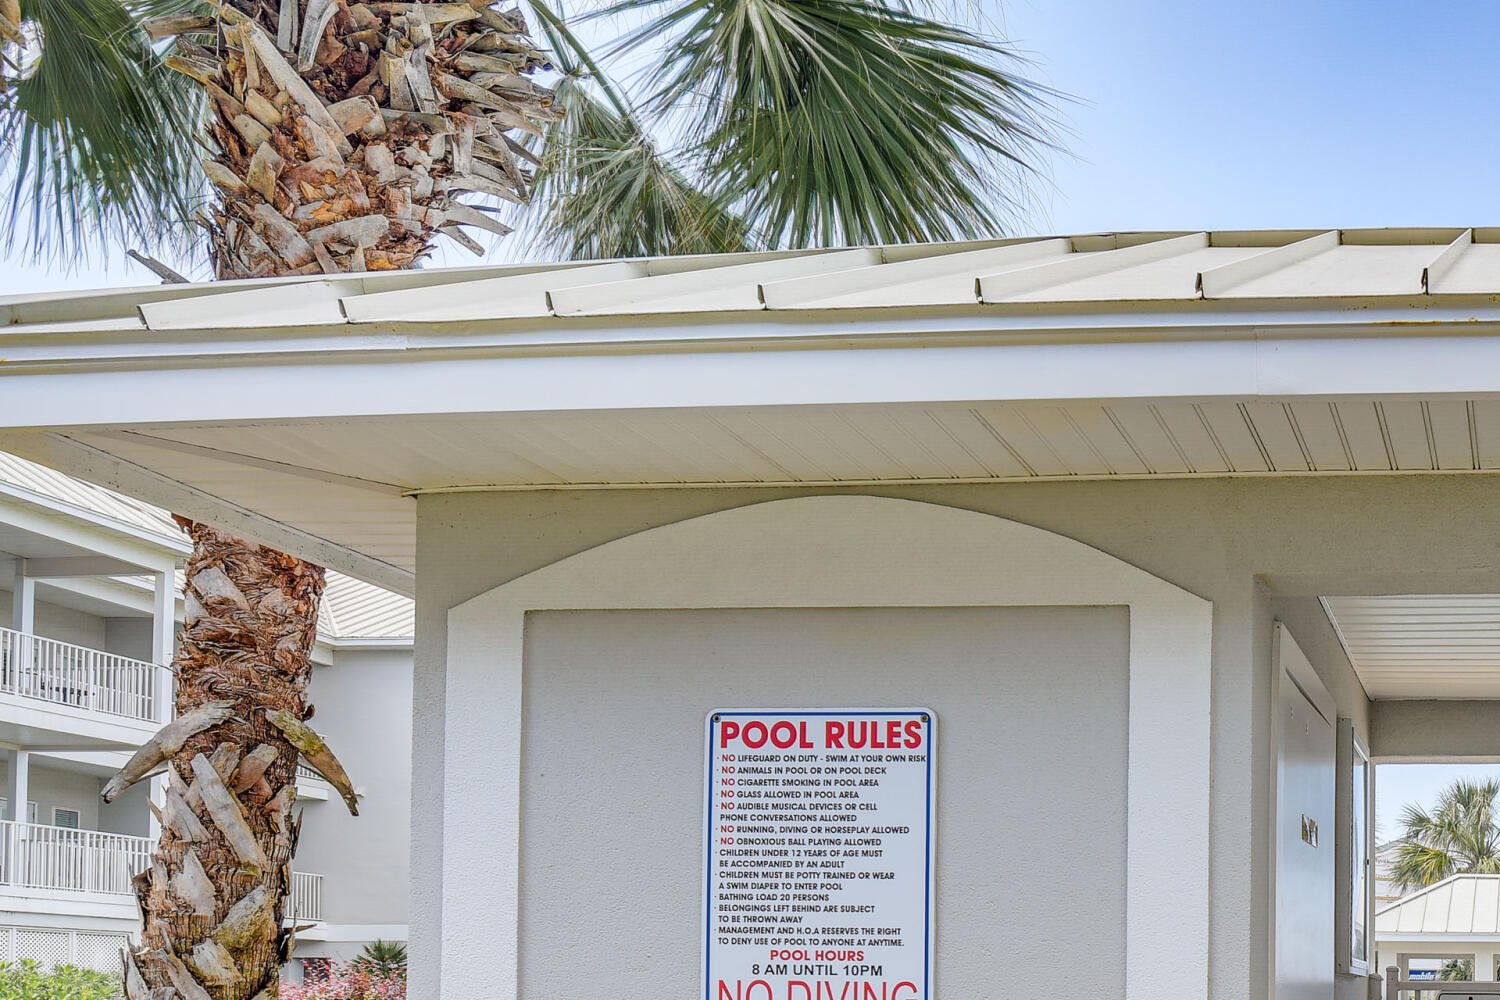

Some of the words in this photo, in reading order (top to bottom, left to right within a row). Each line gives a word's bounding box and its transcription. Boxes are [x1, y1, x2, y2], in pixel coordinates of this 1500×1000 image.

[721, 721, 814, 749] POOL
[825, 721, 922, 749] RULES
[722, 754, 735, 762] NO
[738, 754, 781, 762] LIFEGUARD
[783, 755, 796, 763] ON
[798, 755, 818, 763] DUTY
[825, 755, 847, 763] SWIM
[850, 755, 859, 763] AT
[861, 755, 884, 763] YOUR
[886, 755, 906, 763] OWN
[908, 755, 926, 763] RISK
[721, 766, 735, 775] NO
[737, 766, 772, 775] ANIMALS
[774, 766, 783, 775] IN
[785, 767, 808, 775] POOL
[810, 767, 822, 775] OR
[824, 767, 837, 775] ON
[839, 767, 862, 775] POOL
[864, 767, 887, 775] DECK
[721, 778, 735, 787] NO
[737, 778, 780, 787] CIGARETTE
[782, 779, 821, 787] SMOKING
[823, 779, 832, 787] IN
[834, 779, 856, 787] POOL
[858, 779, 879, 787] AREA
[721, 791, 734, 799] NO
[737, 791, 762, 799] GLASS
[763, 791, 801, 799] ALLOWED
[803, 791, 812, 799] IN
[814, 791, 836, 799] POOL
[838, 791, 859, 799] AREA
[721, 803, 735, 811] NO
[737, 803, 769, 811] AUDIBLE
[771, 803, 807, 811] MUSICAL
[809, 803, 842, 811] DEVICES
[845, 803, 857, 811] OR
[859, 803, 878, 811] CELL
[720, 814, 748, 822] PHONE
[750, 814, 817, 822] CONVERSATIONS
[819, 814, 857, 822] ALLOWED
[721, 825, 734, 834] NO
[780, 826, 808, 834] DIVING
[810, 826, 822, 834] OR
[825, 826, 870, 834] HORSEPLAY
[872, 826, 910, 835] ALLOWED
[721, 837, 734, 846] NO
[736, 837, 786, 846] OBNOXIOUS
[788, 837, 806, 846] BALL
[808, 838, 842, 846] PLAYING
[844, 838, 881, 846] ALLOWED
[719, 849, 759, 857] CHILDREN
[861, 850, 883, 858] MUST
[719, 860, 728, 868] BE
[730, 861, 792, 869] ACCOMPANIED
[795, 861, 805, 869] BY
[806, 861, 818, 869] AN
[820, 861, 845, 869] ADULT
[719, 872, 759, 880] CHILDREN
[762, 872, 783, 880] MUST
[785, 872, 794, 880] BE
[797, 872, 821, 880] POTTY
[823, 872, 856, 880] TRAINED
[858, 872, 870, 880] OR
[872, 872, 895, 880] WEAR
[718, 882, 724, 890] A
[781, 883, 792, 891] TO
[795, 883, 818, 891] ENTER
[820, 883, 843, 891] POOL
[756, 894, 778, 902] LOAD
[780, 894, 790, 902] 20
[793, 894, 829, 902] PERSONS
[718, 905, 771, 913] BELONGINGS
[774, 905, 790, 913] LEFT
[792, 905, 821, 913] BEHIND
[823, 905, 838, 913] ARE
[840, 905, 875, 913] SUBJECT
[718, 915, 730, 923] TO
[732, 915, 741, 923] BE
[743, 916, 778, 924] THROWN
[780, 916, 803, 924] AWAY
[718, 927, 776, 935] MANAGEMENT
[777, 927, 794, 935] AND
[822, 927, 859, 936] RESERVES
[861, 928, 875, 936] THE
[878, 928, 901, 936] RIGHT
[718, 938, 729, 946] TO
[731, 938, 752, 946] DENY
[754, 938, 769, 946] USE
[771, 938, 783, 946] OF
[784, 938, 807, 946] POOL
[809, 938, 820, 946] TO
[822, 939, 856, 947] ANYONE
[857, 939, 867, 947] AT
[770, 950, 811, 961] POOL
[816, 951, 865, 961] HOURS
[752, 964, 760, 976] 8
[765, 965, 788, 976] AM
[793, 965, 838, 976] UNTIL
[843, 965, 883, 977] 10PM
